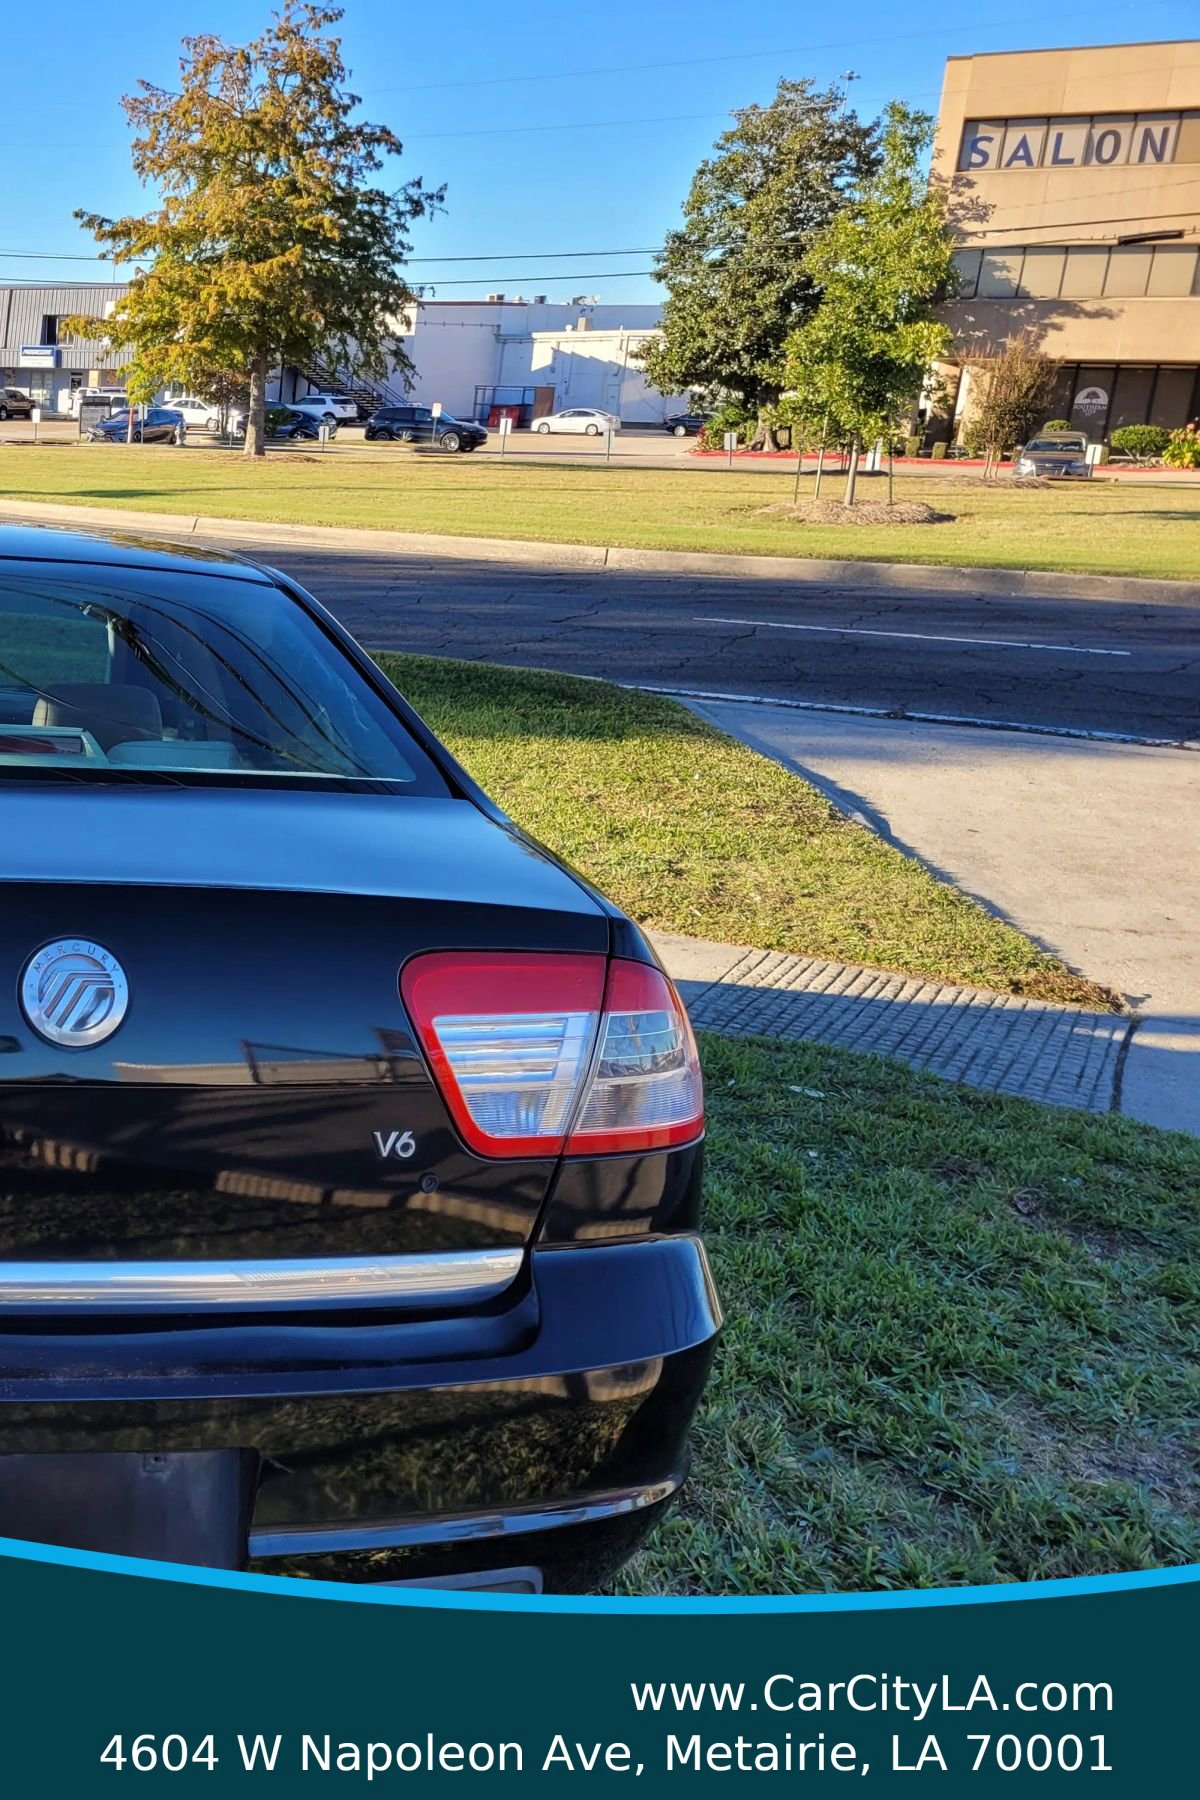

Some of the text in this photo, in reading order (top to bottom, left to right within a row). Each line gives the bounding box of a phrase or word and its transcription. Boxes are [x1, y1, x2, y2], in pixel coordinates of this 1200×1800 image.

[968, 126, 1171, 169] SALON
[33, 943, 119, 974] MERCURY
[372, 1130, 416, 1158] V6
